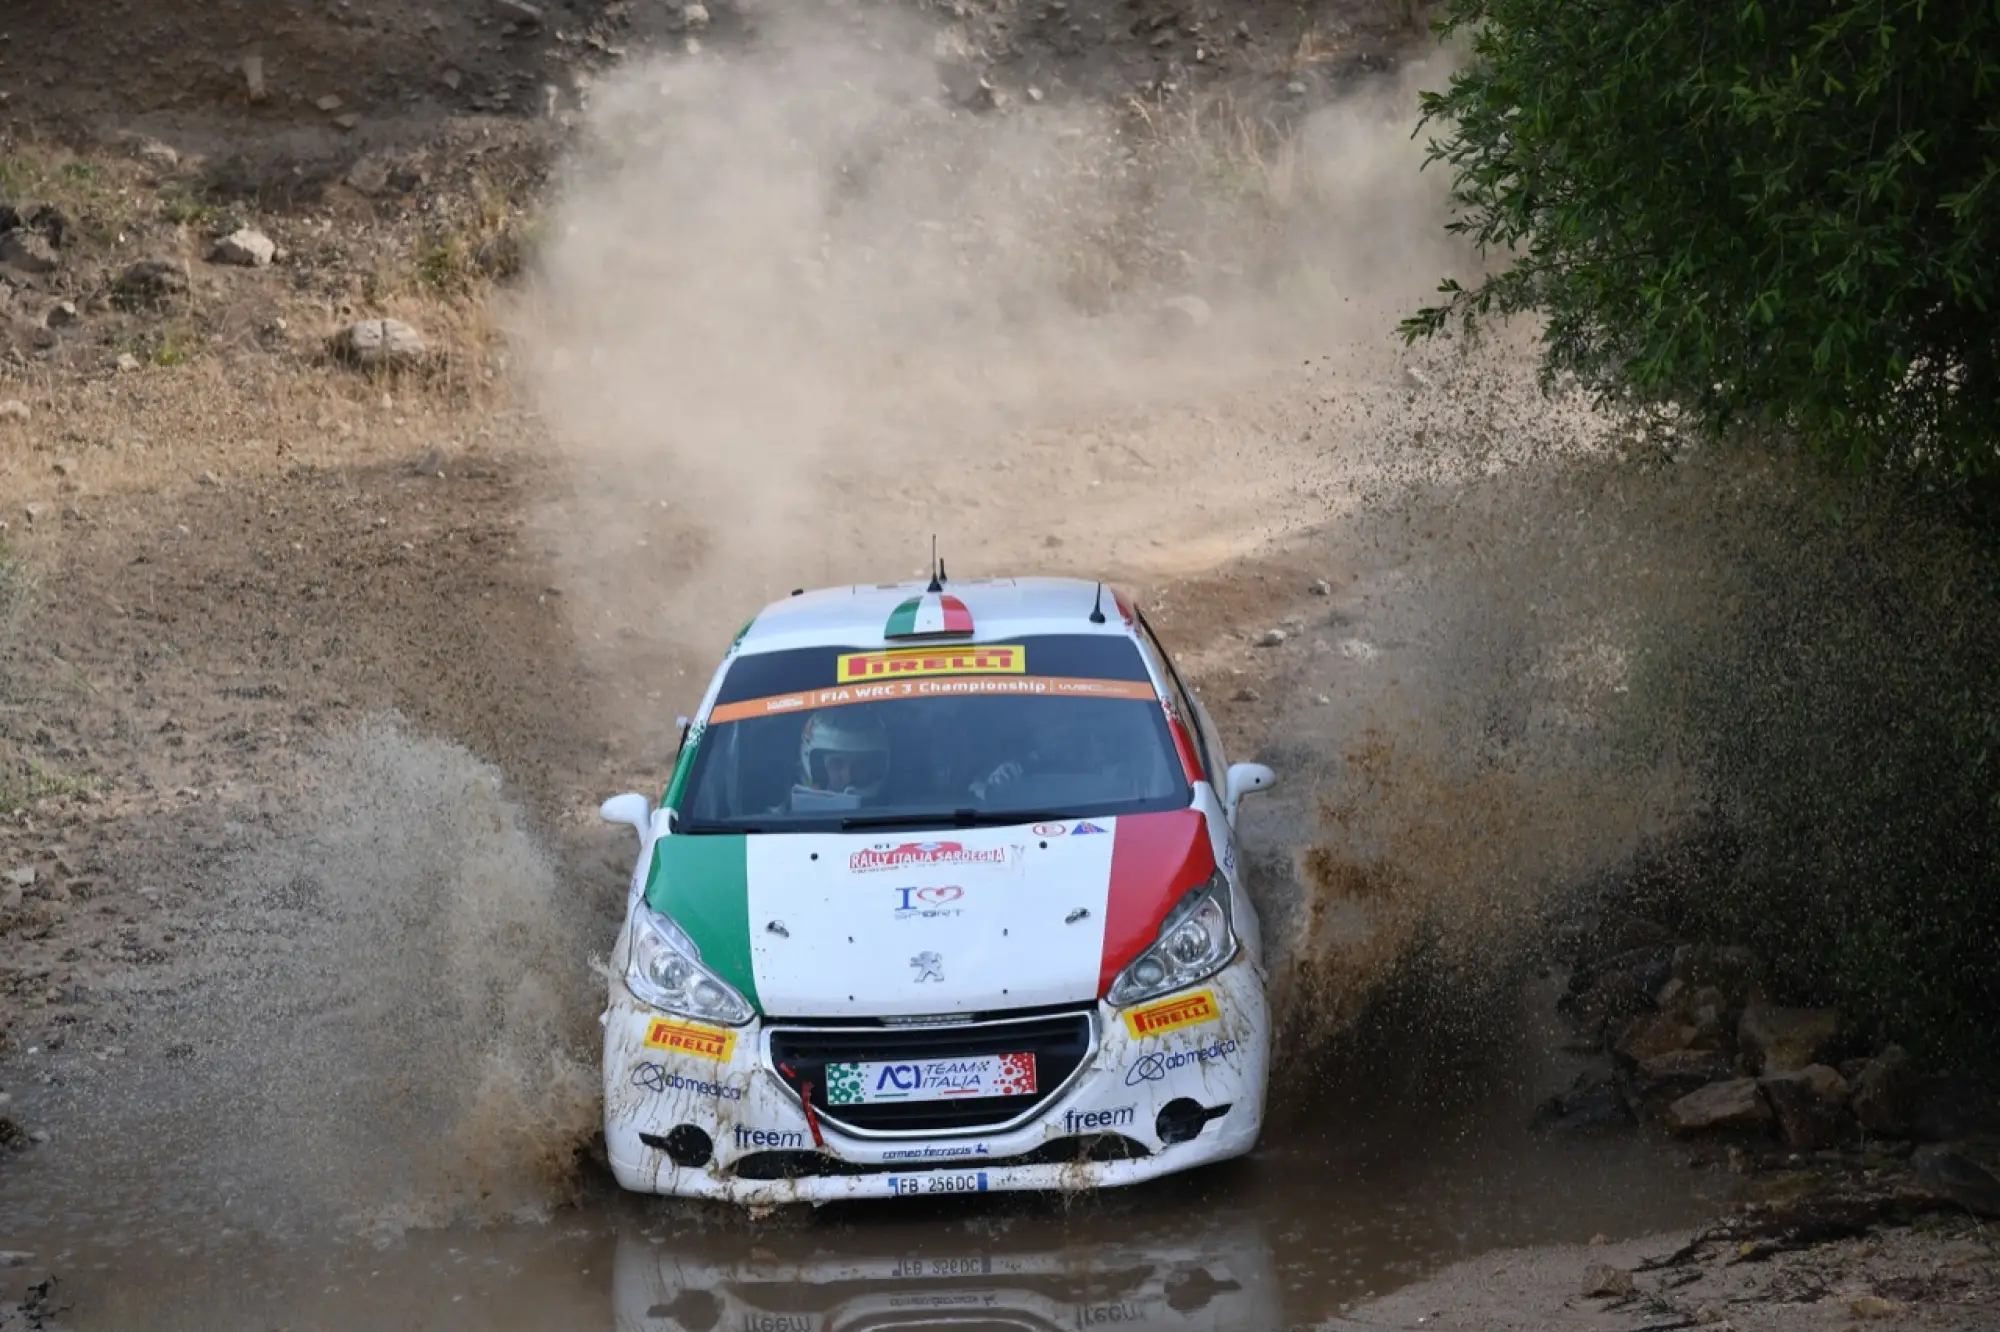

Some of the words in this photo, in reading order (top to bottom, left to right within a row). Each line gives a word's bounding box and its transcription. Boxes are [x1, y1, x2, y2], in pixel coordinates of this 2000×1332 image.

[847, 649, 1014, 677] PIRELLI
[820, 691, 849, 703] FIA
[855, 683, 896, 698] WRC
[901, 683, 913, 694] 3
[919, 679, 1046, 694] Championship
[849, 849, 889, 869] RALLY
[893, 848, 932, 865] ITALIA
[935, 846, 1006, 863] SARDEGNA
[1133, 995, 1211, 1034] PIRELLI
[651, 1023, 727, 1056] PIRELLI
[876, 1064, 922, 1091] ACI
[924, 1061, 977, 1075] TEAM
[921, 1074, 981, 1089] ITALIA
[1064, 1106, 1135, 1133] freem
[734, 1123, 803, 1148] freem
[900, 1178, 919, 1194] FB
[927, 1175, 976, 1192] 256DC
